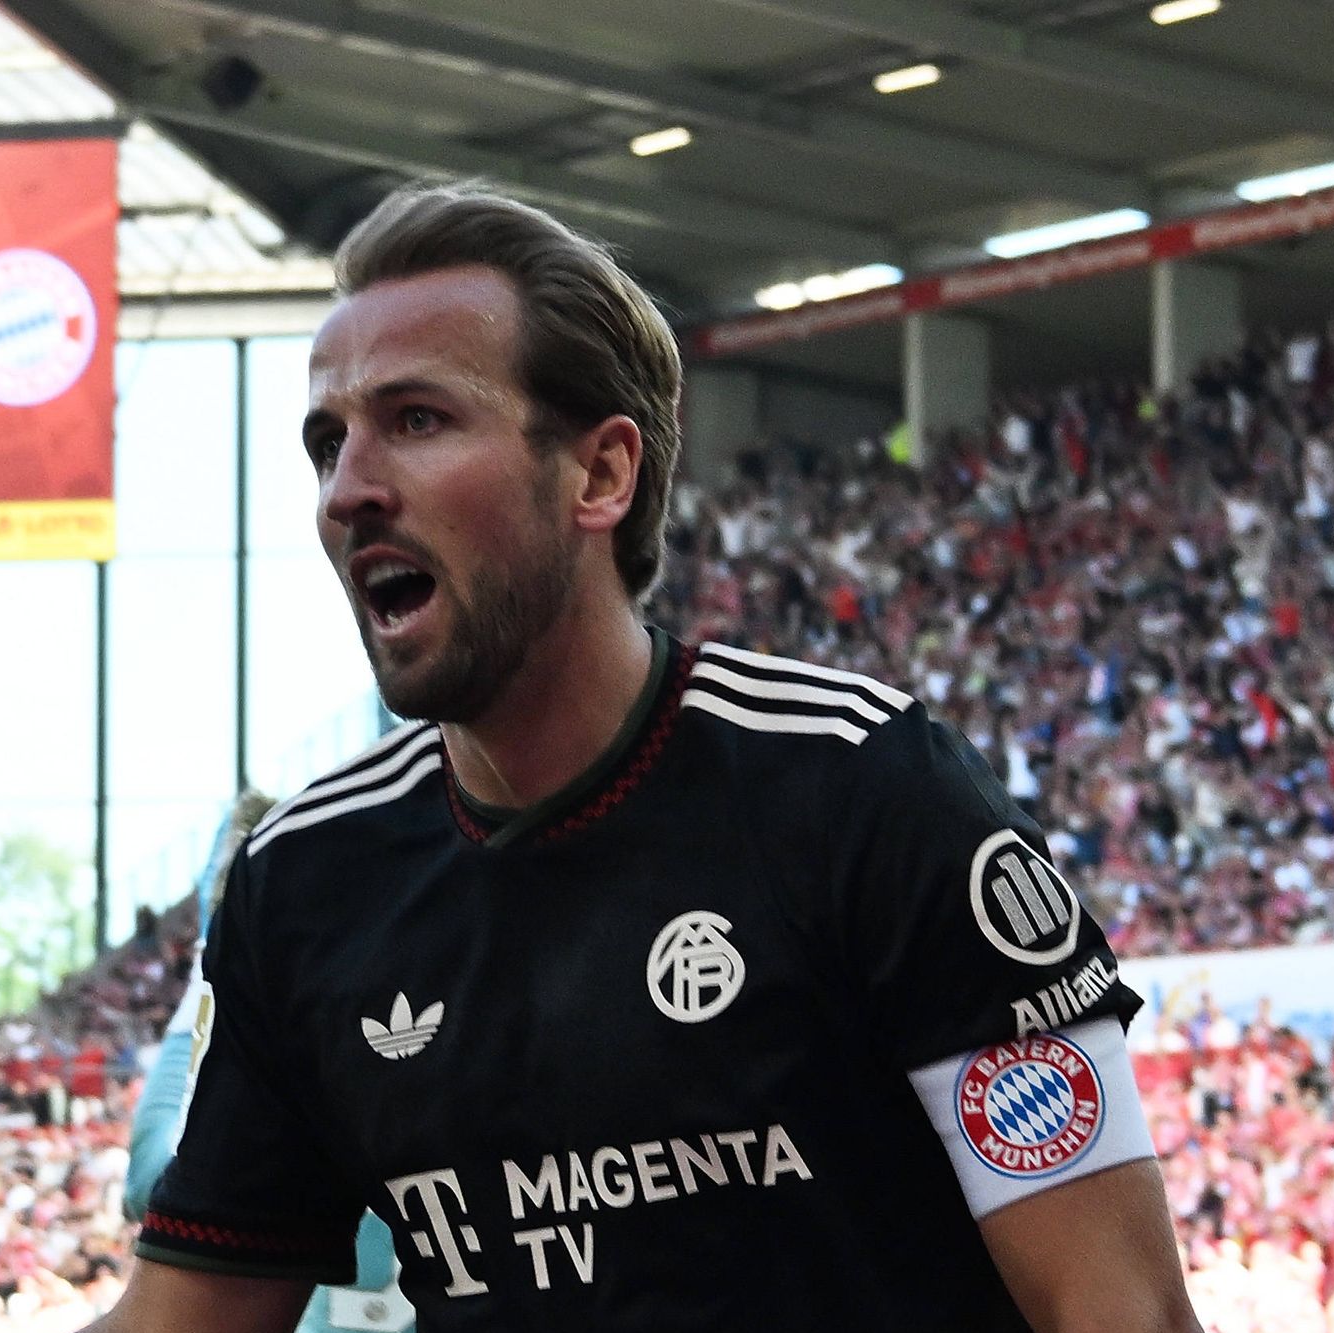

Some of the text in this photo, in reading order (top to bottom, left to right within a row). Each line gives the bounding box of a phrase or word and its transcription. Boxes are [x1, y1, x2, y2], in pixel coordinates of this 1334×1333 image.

[1010, 956, 1116, 1040] Allianz
[964, 1038, 1084, 1115] FC BAYERN
[501, 1123, 814, 1220] MAGENTA
[513, 1222, 594, 1290] TV
